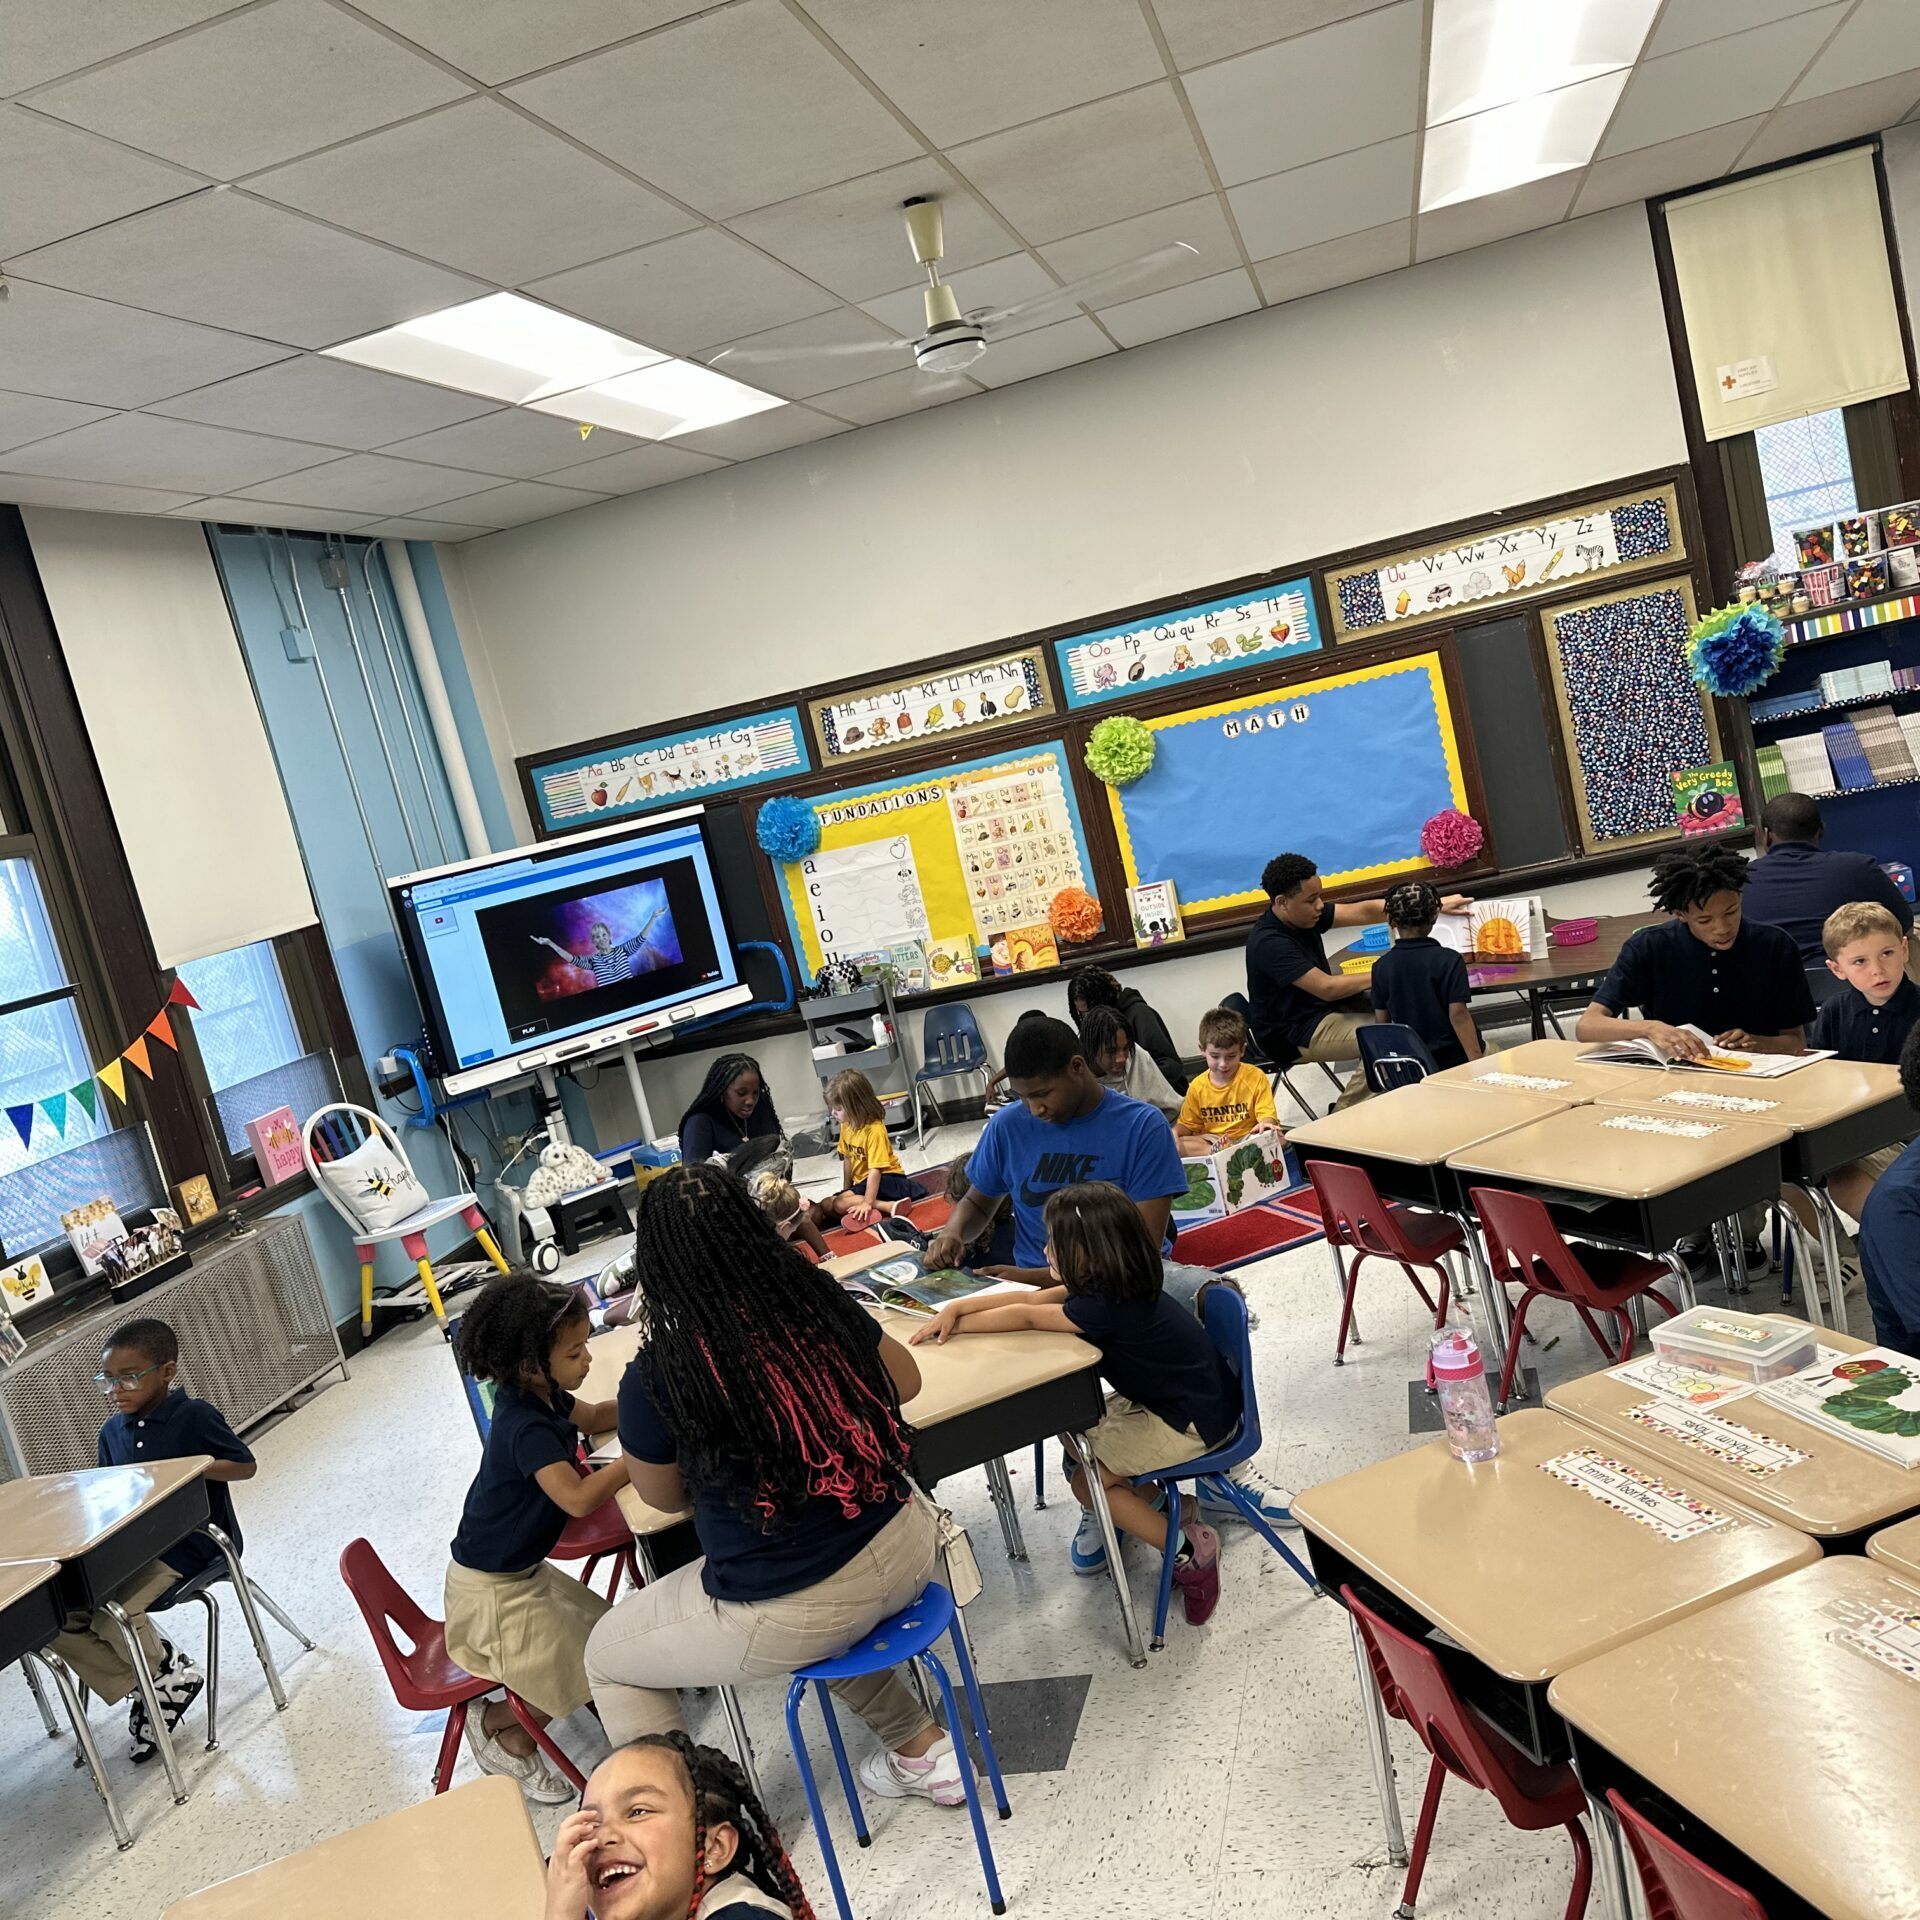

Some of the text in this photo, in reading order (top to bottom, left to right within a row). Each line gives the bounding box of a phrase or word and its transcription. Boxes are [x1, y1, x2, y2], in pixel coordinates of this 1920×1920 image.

[1388, 519, 1594, 583] Uu Vv Ww Xx Yy Zz
[1089, 643, 1110, 657] Oo
[1123, 635, 1140, 654] Pp
[1154, 627, 1175, 640] Qu
[1205, 614, 1220, 629] Rr
[1236, 606, 1251, 621] Ss
[1263, 597, 1280, 613] Tt
[838, 664, 1018, 718] Hh Ii Jj Kk Ll Mm Nn
[1226, 707, 1306, 736] MATH
[587, 730, 752, 778] Aa Bb Cc Dd Ee Ff Gg
[1676, 769, 1732, 791] Very Greedy
[1715, 778, 1733, 787] Bee
[821, 787, 940, 825] FUNDATIONS
[804, 860, 817, 874] a
[810, 883, 821, 896] e
[817, 905, 826, 921] i
[821, 929, 833, 942] o
[825, 951, 839, 965] u
[1200, 1102, 1249, 1117] STANTON
[273, 1146, 301, 1170] happy
[1031, 1152, 1103, 1183] NIKE
[1682, 1420, 1758, 1457] Hakim Hayes
[1578, 1461, 1661, 1508] Emma Voorhees
